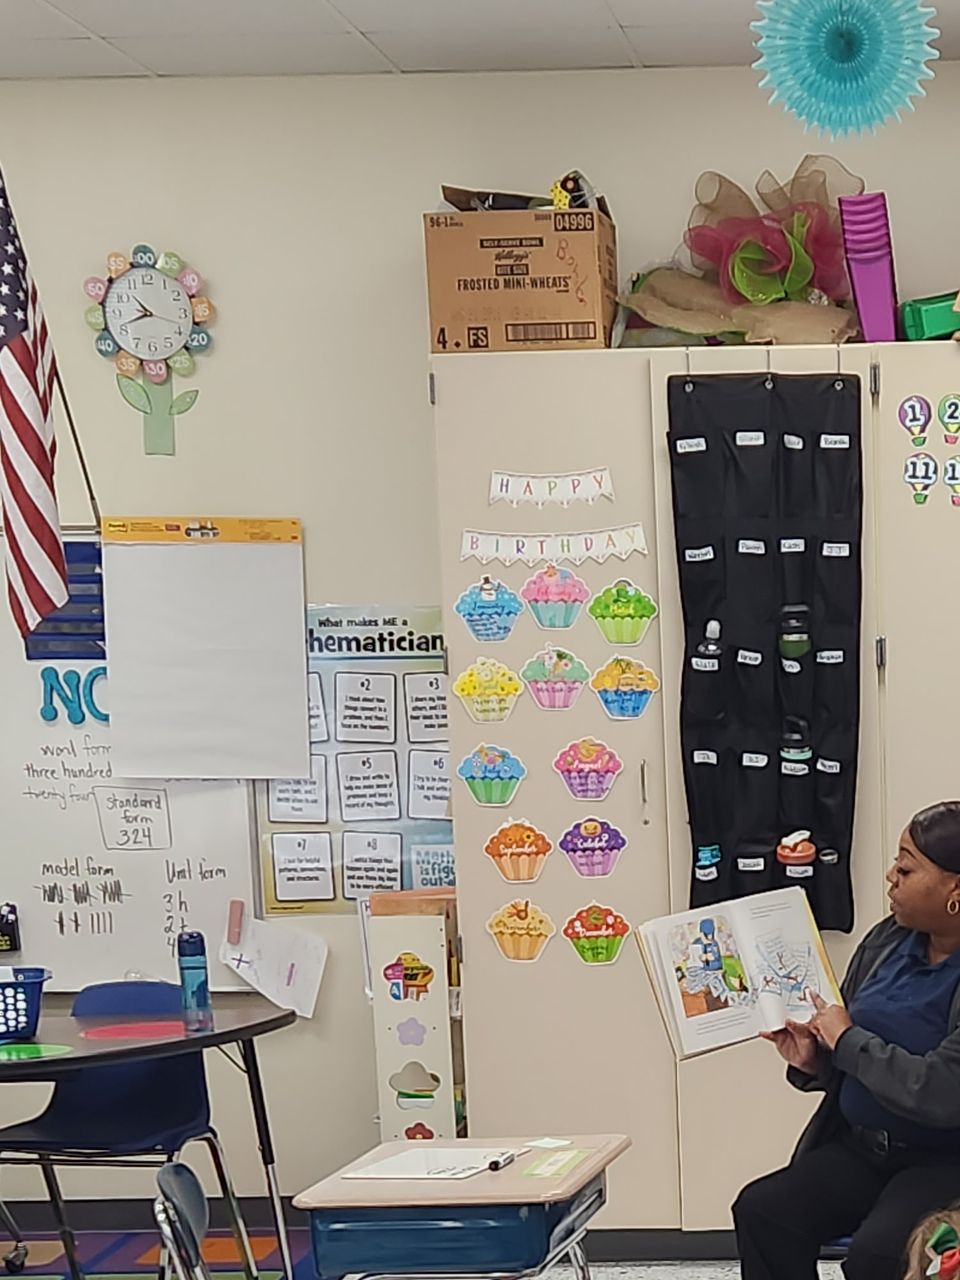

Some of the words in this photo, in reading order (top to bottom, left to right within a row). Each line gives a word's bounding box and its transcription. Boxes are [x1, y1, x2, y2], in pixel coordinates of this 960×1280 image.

[556, 213, 593, 230] 04996
[494, 249, 529, 262] Kellogg's
[128, 278, 137, 290] 11
[141, 273, 154, 285] 12
[162, 278, 167, 290] 1
[457, 278, 499, 291] FROSTED
[503, 276, 570, 290] MINI-WHEATS
[117, 292, 130, 304] 10
[172, 289, 181, 301] 2
[112, 307, 122, 319] 9
[178, 307, 188, 320] 3
[119, 324, 129, 336] 8
[174, 326, 182, 336] 4
[468, 327, 487, 346] FS
[132, 337, 142, 349] 7
[163, 337, 173, 348] 5
[437, 327, 448, 349] 4
[148, 341, 158, 352] 6
[908, 404, 921, 422] 1
[947, 401, 959, 420] 2
[908, 461, 933, 480] 11
[499, 474, 604, 496] HAPPY
[469, 531, 636, 555] BIRTHDAY
[318, 617, 343, 628] What
[347, 617, 379, 627] makes
[382, 617, 398, 626] ME
[402, 619, 408, 627] a
[308, 628, 444, 653] hematician
[360, 678, 371, 691] #2
[429, 677, 440, 690] #3
[361, 757, 372, 769] #5
[433, 757, 444, 769] #6
[24, 762, 59, 780] three
[62, 760, 112, 780] hundred
[121, 809, 154, 825] form
[116, 827, 153, 848] 324
[297, 838, 307, 851] #7
[499, 845, 538, 858] September
[41, 858, 81, 878] model
[84, 859, 115, 877] form
[420, 866, 430, 876] is
[577, 926, 615, 936] December
